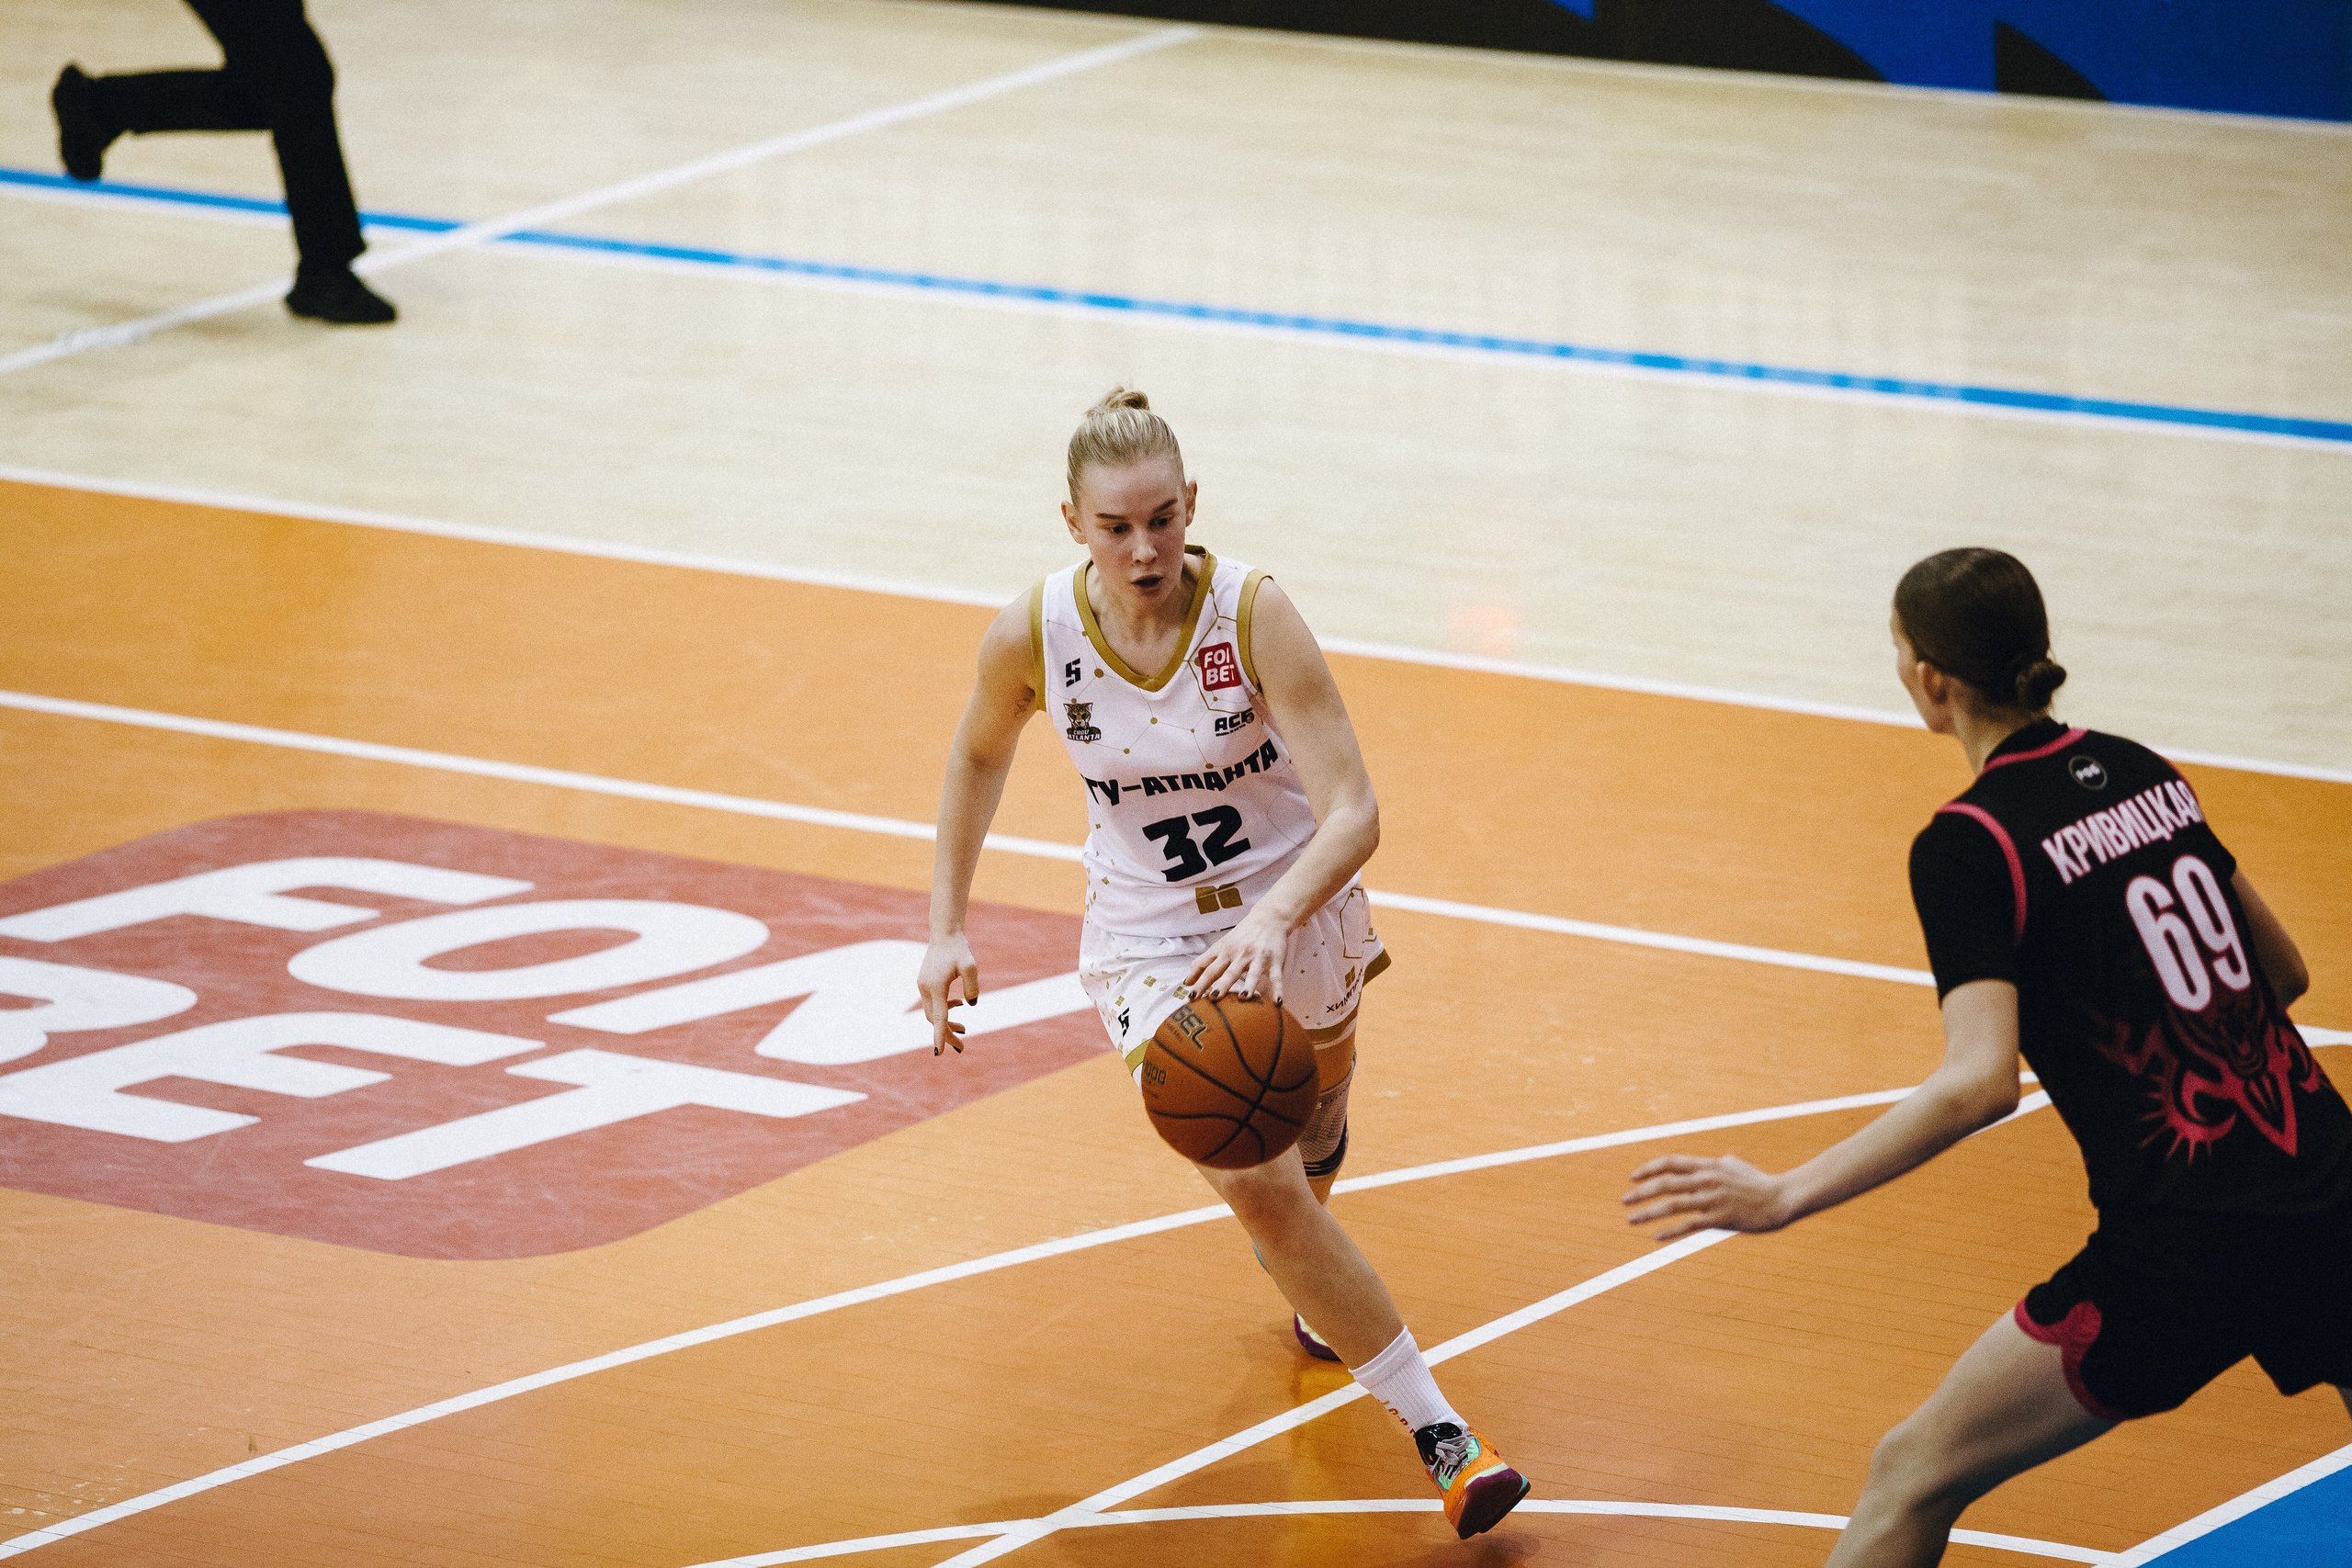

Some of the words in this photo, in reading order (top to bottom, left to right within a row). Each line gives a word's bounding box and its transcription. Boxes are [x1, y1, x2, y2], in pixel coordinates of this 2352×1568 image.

[1080, 739, 1279, 807] ГУ-АТЛАНТА
[1142, 805, 1251, 882] 32
[0, 857, 1096, 1065] FON
[2125, 853, 2251, 1012] 69
